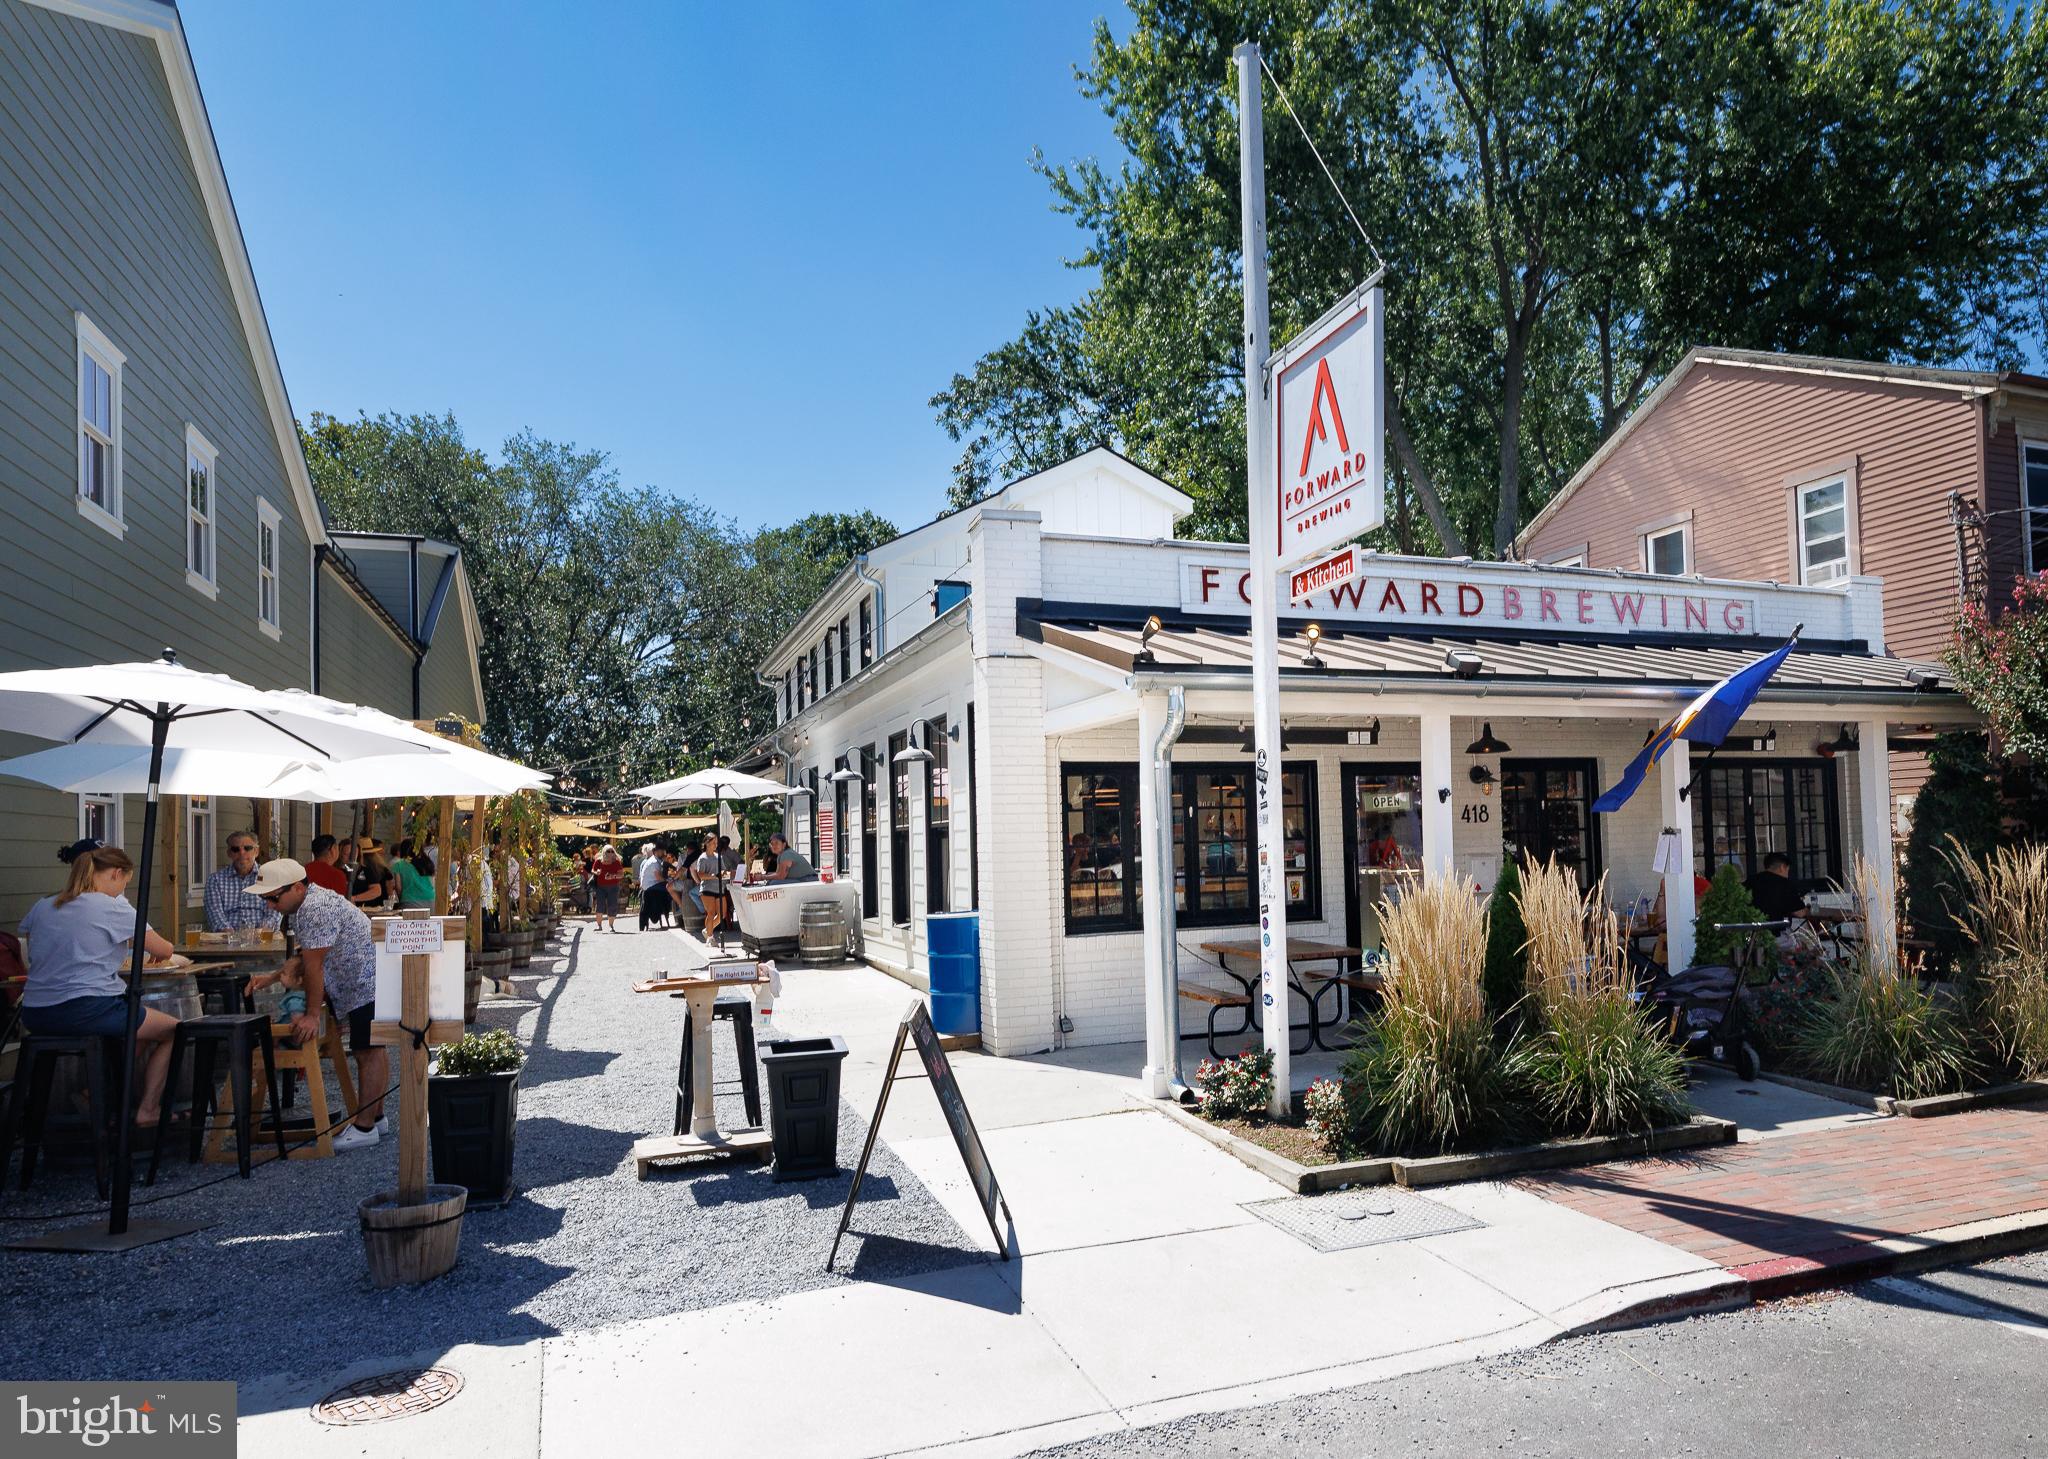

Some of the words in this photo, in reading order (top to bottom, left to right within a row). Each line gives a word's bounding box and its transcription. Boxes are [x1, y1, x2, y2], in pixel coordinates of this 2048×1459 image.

[1285, 452, 1367, 511] FORWARD
[1297, 498, 1351, 534] BREWING
[1295, 576, 1305, 597] &
[1304, 557, 1352, 593] Kitchen
[1201, 568, 1485, 618] FWARD
[1503, 585, 1745, 633] BREWING
[1373, 796, 1400, 808] OPEN
[1460, 803, 1490, 824] 418
[752, 891, 778, 903] ORDER
